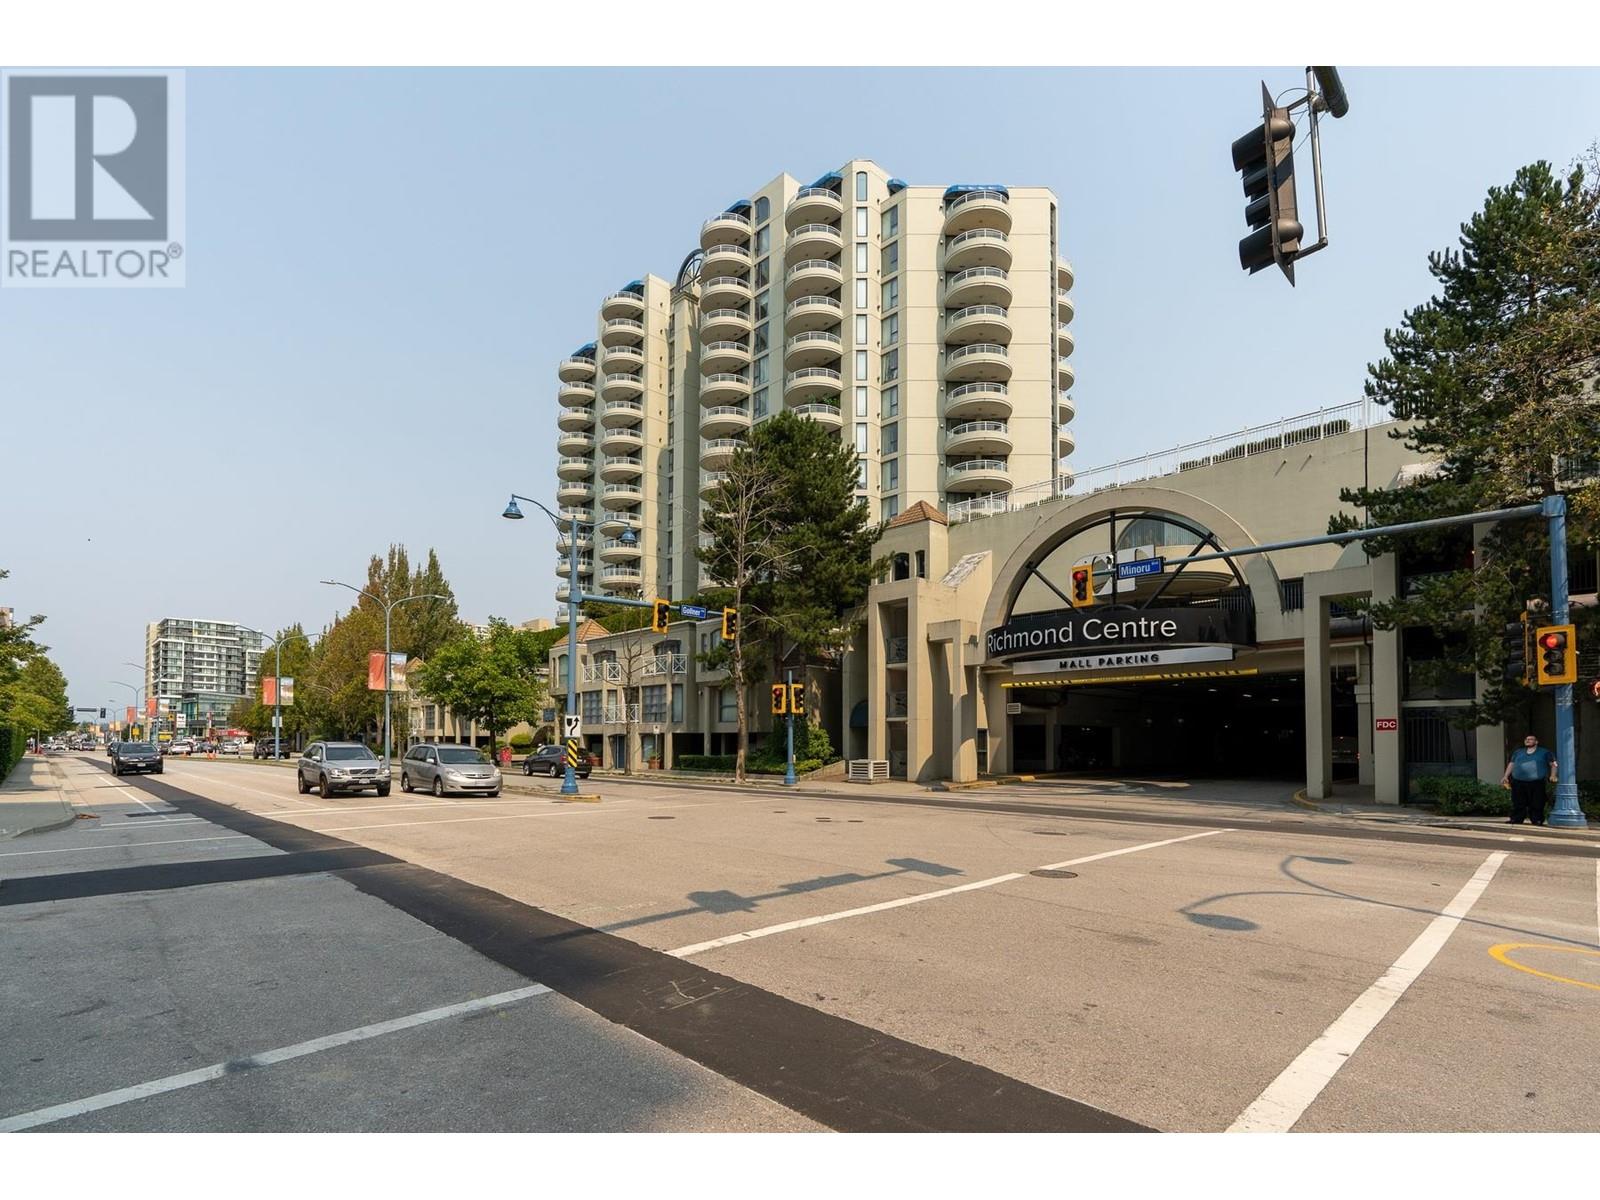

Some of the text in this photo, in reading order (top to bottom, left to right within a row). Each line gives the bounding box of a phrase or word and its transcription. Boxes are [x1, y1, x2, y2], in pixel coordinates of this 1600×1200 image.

[1121, 564, 1151, 576] Minoru
[987, 617, 1177, 653] Richmond Centre
[1059, 653, 1160, 669] MALL PARKING
